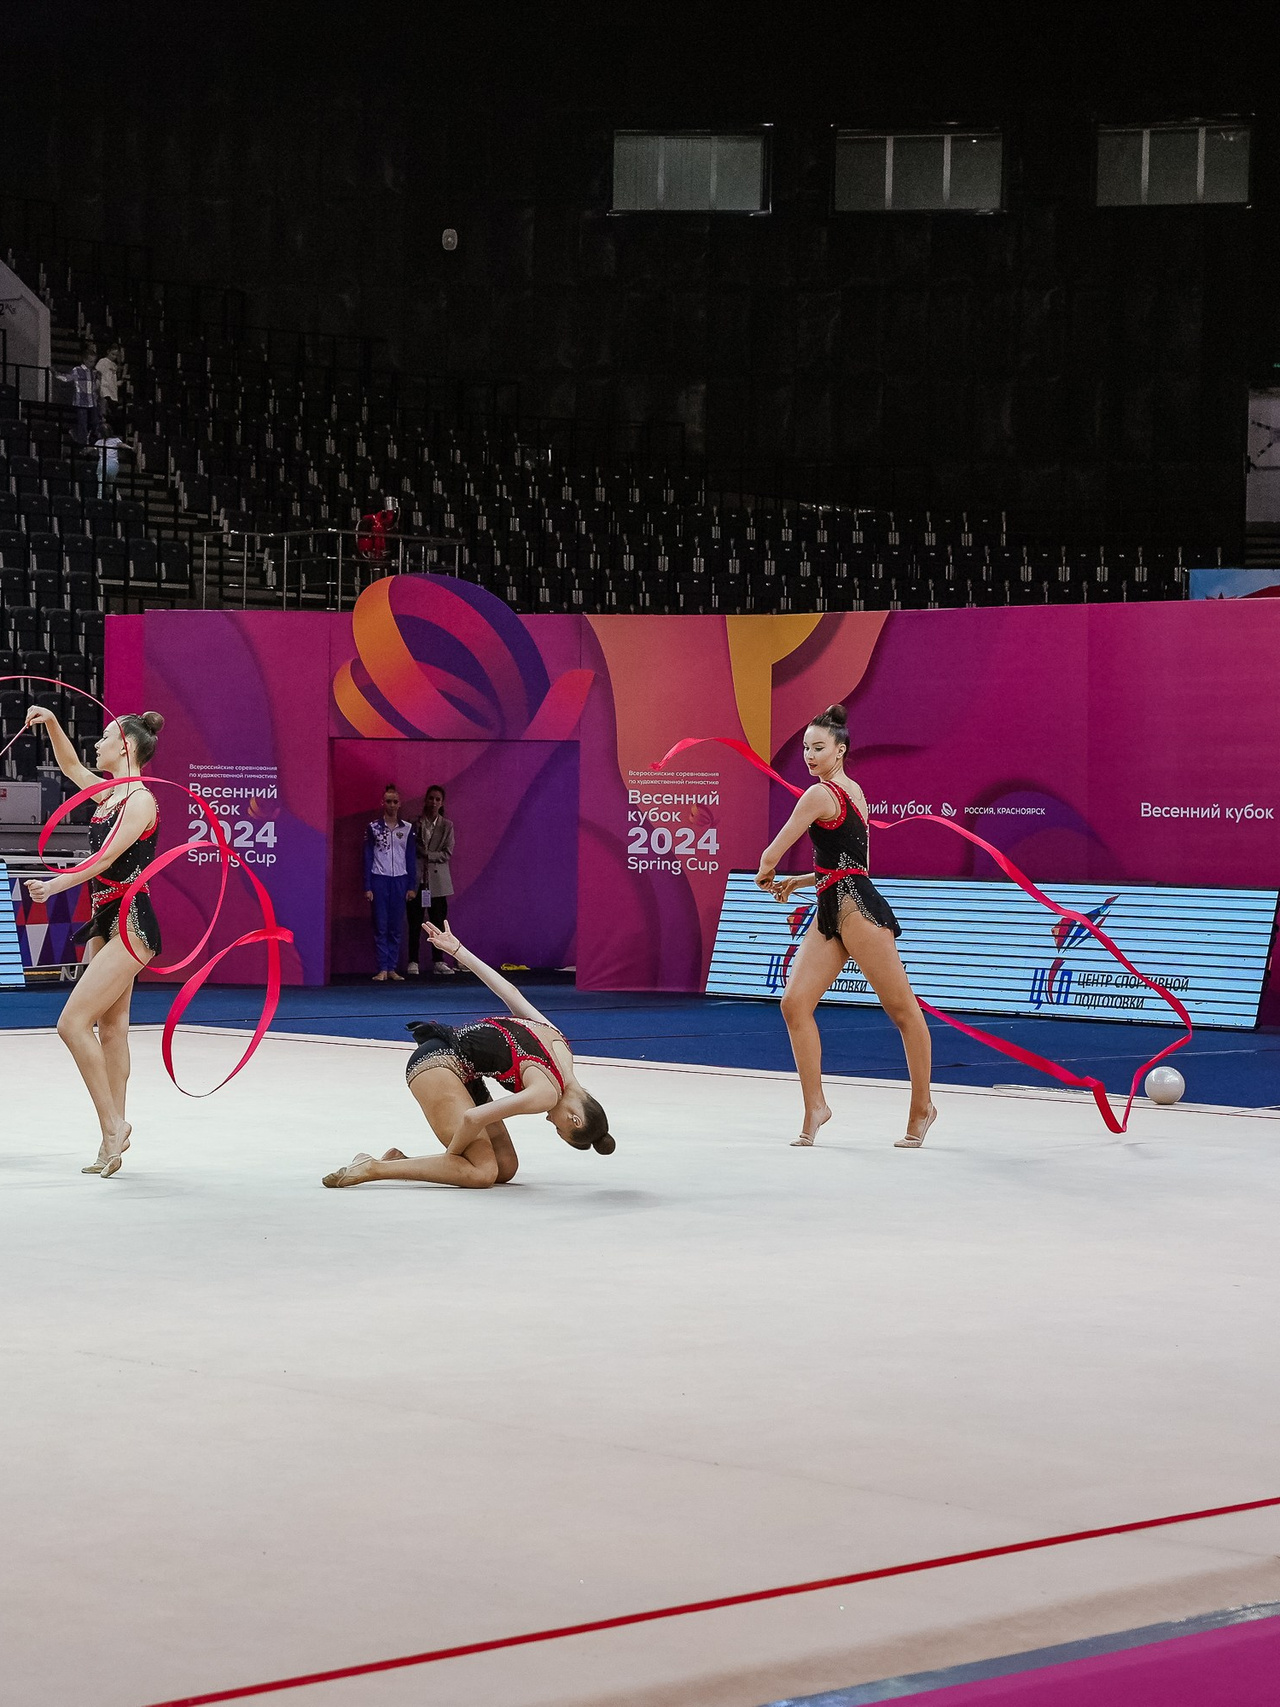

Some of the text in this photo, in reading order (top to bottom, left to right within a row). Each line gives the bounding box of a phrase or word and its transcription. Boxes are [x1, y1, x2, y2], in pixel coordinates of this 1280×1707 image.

[189, 783, 277, 799] Весенний
[628, 790, 719, 805] Весенний
[189, 801, 240, 818] кубок
[628, 807, 681, 825] кубок
[892, 800, 933, 818] кубок
[964, 806, 1046, 815] РОССИЯ, КРАСНОЯРСК
[1141, 802, 1274, 823] Весенний кубок
[188, 820, 277, 848] 2024
[627, 827, 720, 855] 2024
[245, 850, 277, 867] Cup
[627, 856, 719, 875] Spring Cup
[1077, 973, 1113, 988] ЦЕНТР
[1073, 994, 1145, 1010] ПОДГОТОВКИ
